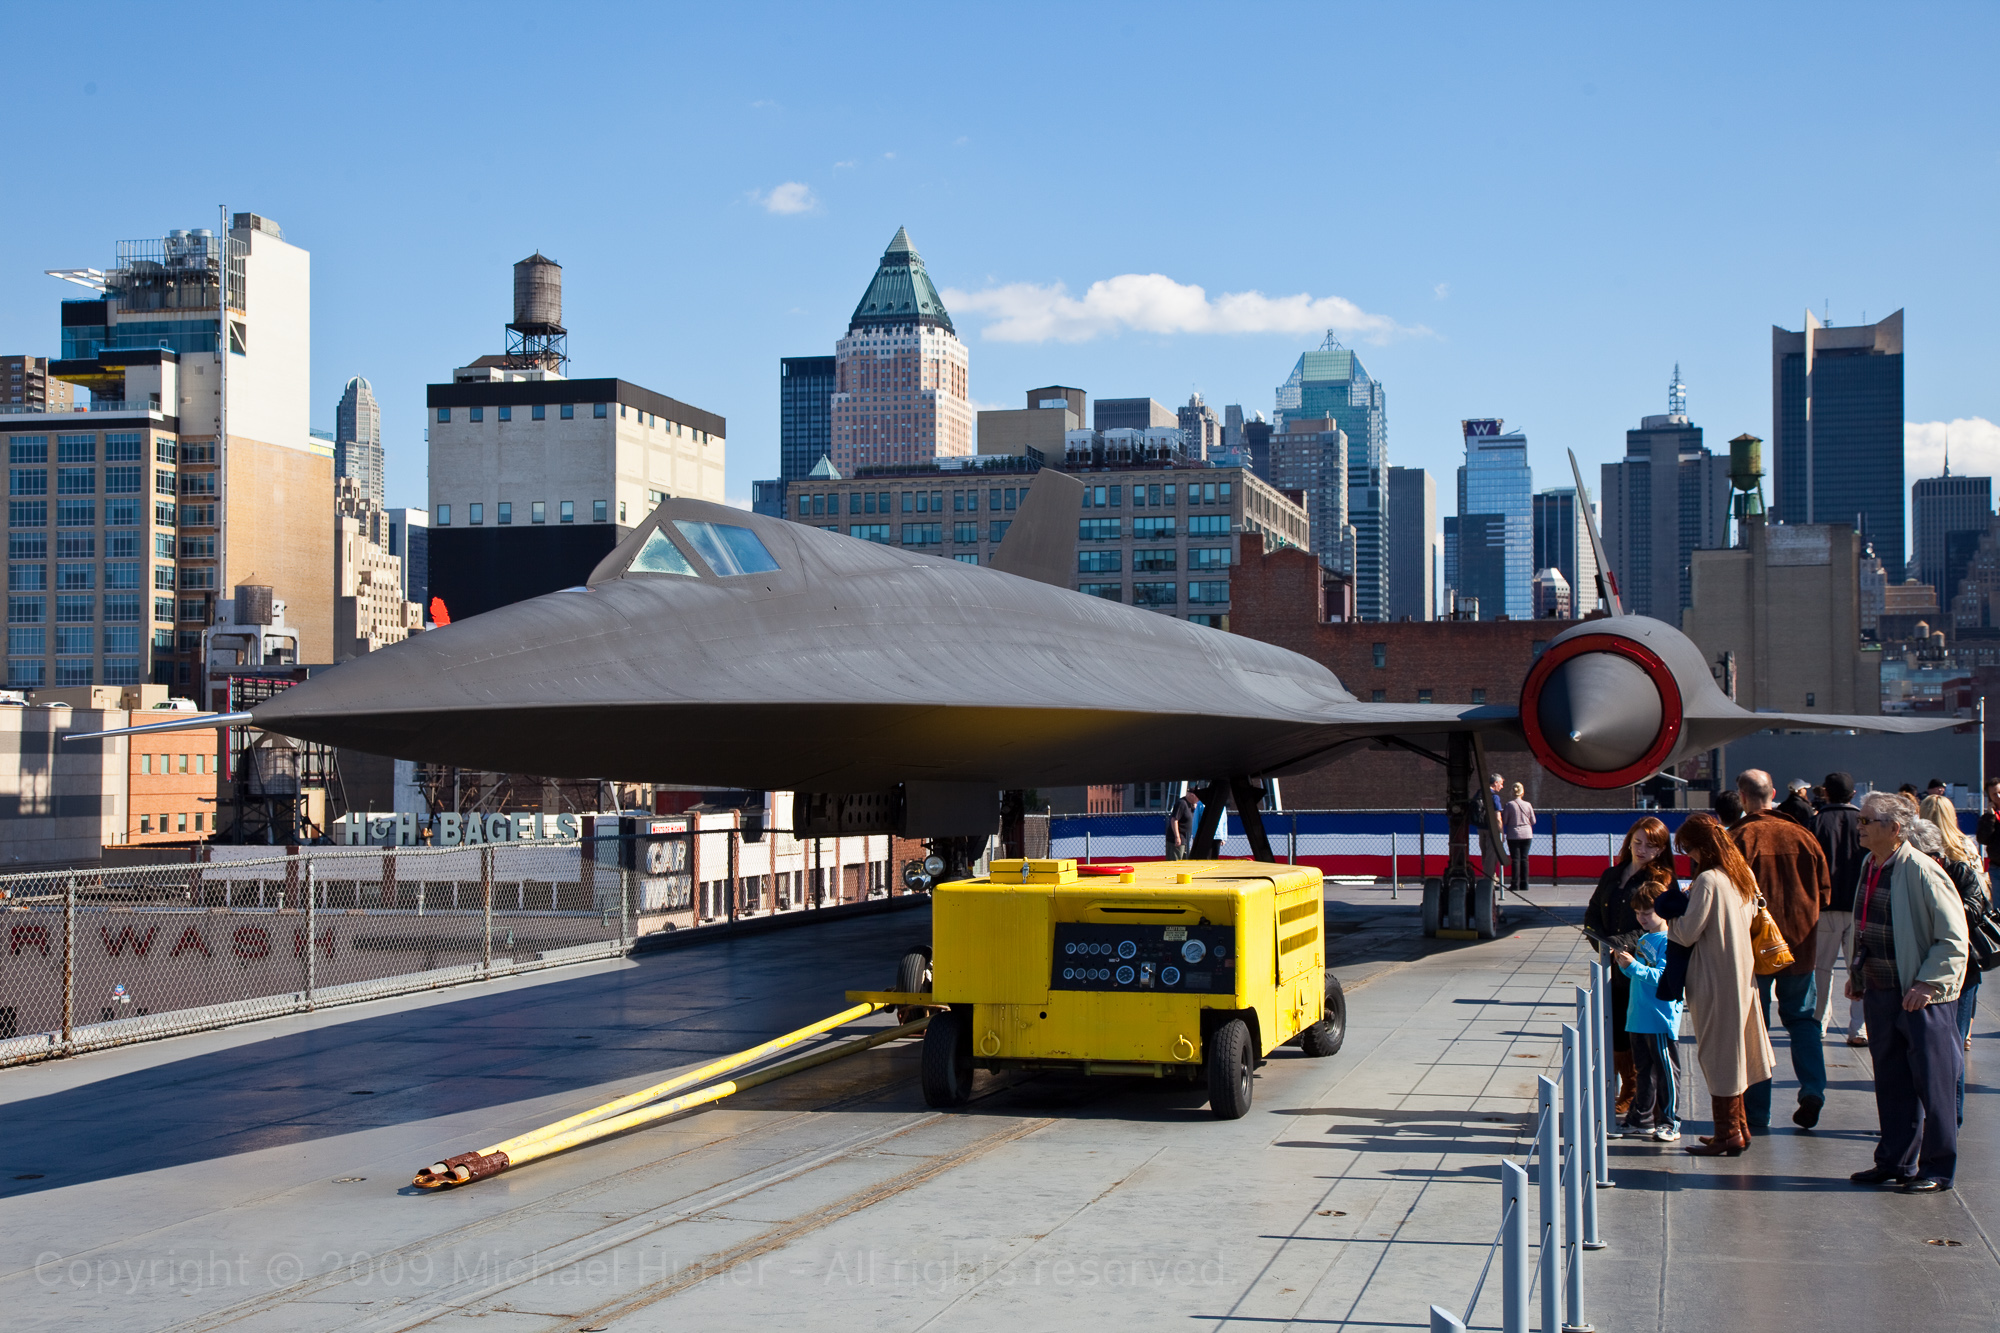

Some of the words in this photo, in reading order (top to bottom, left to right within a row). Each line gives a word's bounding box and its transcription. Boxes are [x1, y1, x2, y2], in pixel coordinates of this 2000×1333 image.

[1472, 423, 1491, 436] W
[345, 811, 420, 847] H&H
[440, 811, 579, 847] BAGELS
[646, 840, 687, 875] CAR
[640, 875, 693, 911] WASH
[100, 925, 337, 959] WASH
